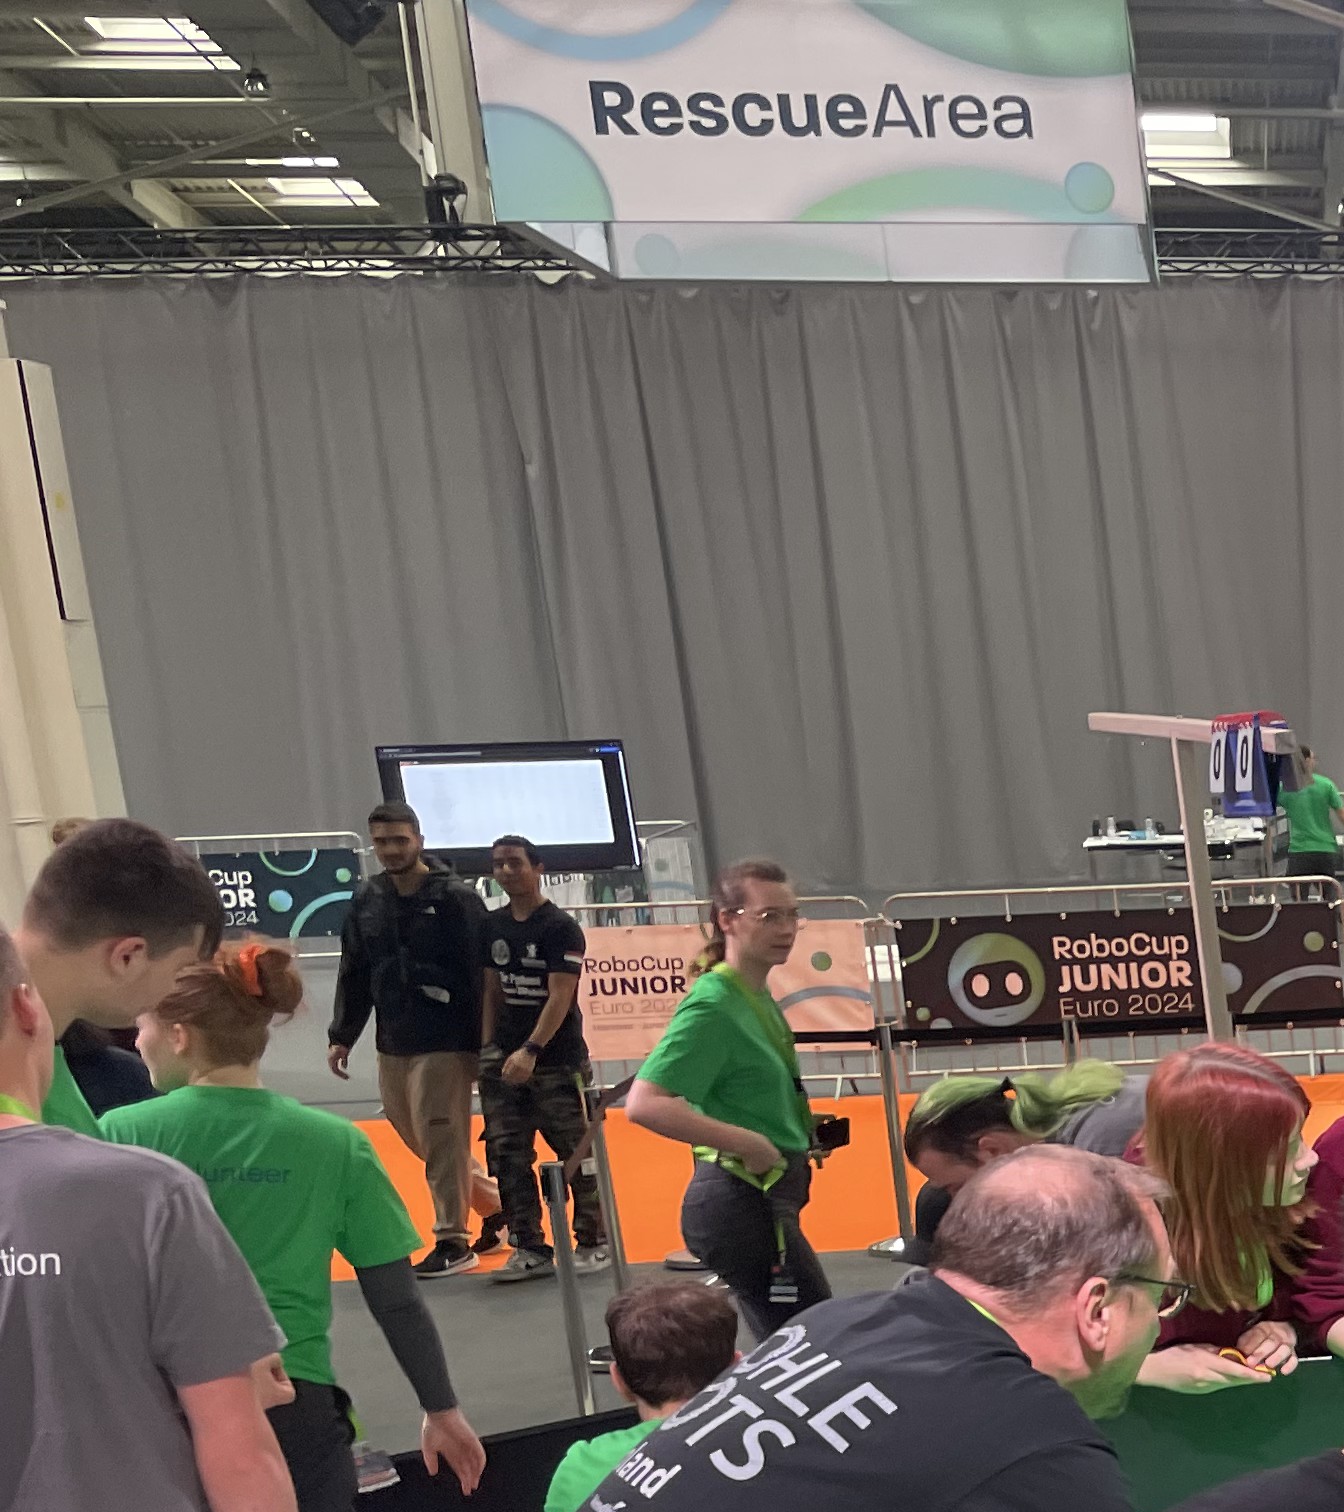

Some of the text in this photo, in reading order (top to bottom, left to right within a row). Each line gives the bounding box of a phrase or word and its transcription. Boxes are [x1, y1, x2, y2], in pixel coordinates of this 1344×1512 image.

[588, 80, 1034, 141] RescueArea
[1240, 735, 1249, 779] 0
[1052, 932, 1190, 960] RoboCup
[584, 955, 684, 975] RoboCup
[1058, 960, 1194, 993] JUNIOR
[588, 975, 688, 997] JUNIOR
[590, 1000, 634, 1016] Euro
[1059, 992, 1196, 1019] Euro 2024
[0, 1246, 61, 1277] tion
